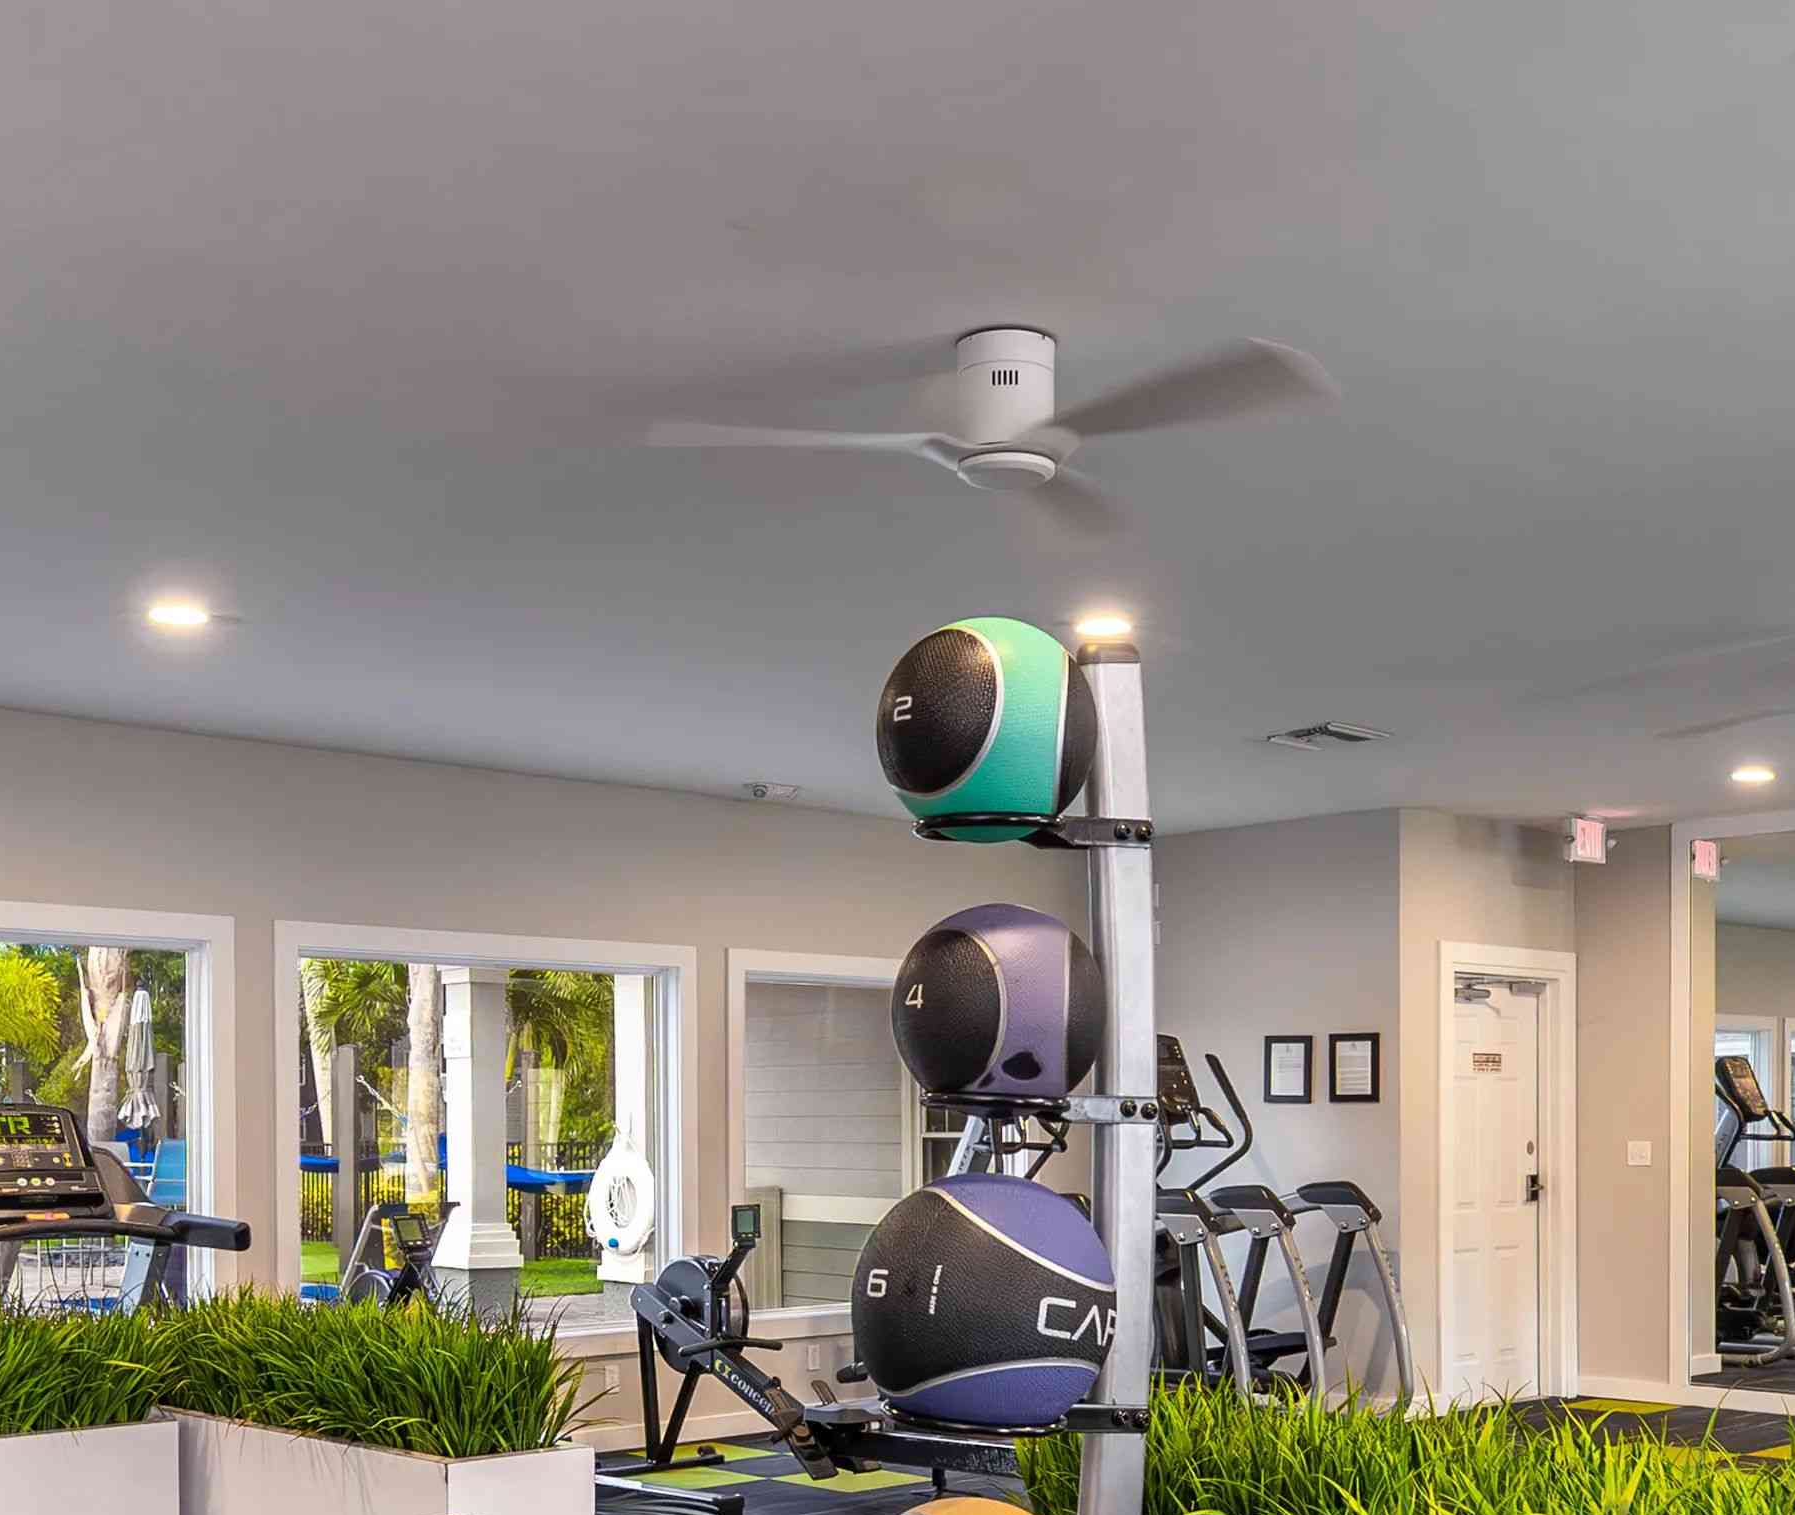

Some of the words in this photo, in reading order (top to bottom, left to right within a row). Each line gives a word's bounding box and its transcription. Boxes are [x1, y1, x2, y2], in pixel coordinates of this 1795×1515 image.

[894, 696, 912, 721] 2
[905, 984, 923, 1008] 4
[867, 1268, 889, 1297] 6
[730, 1373, 777, 1416] concep
